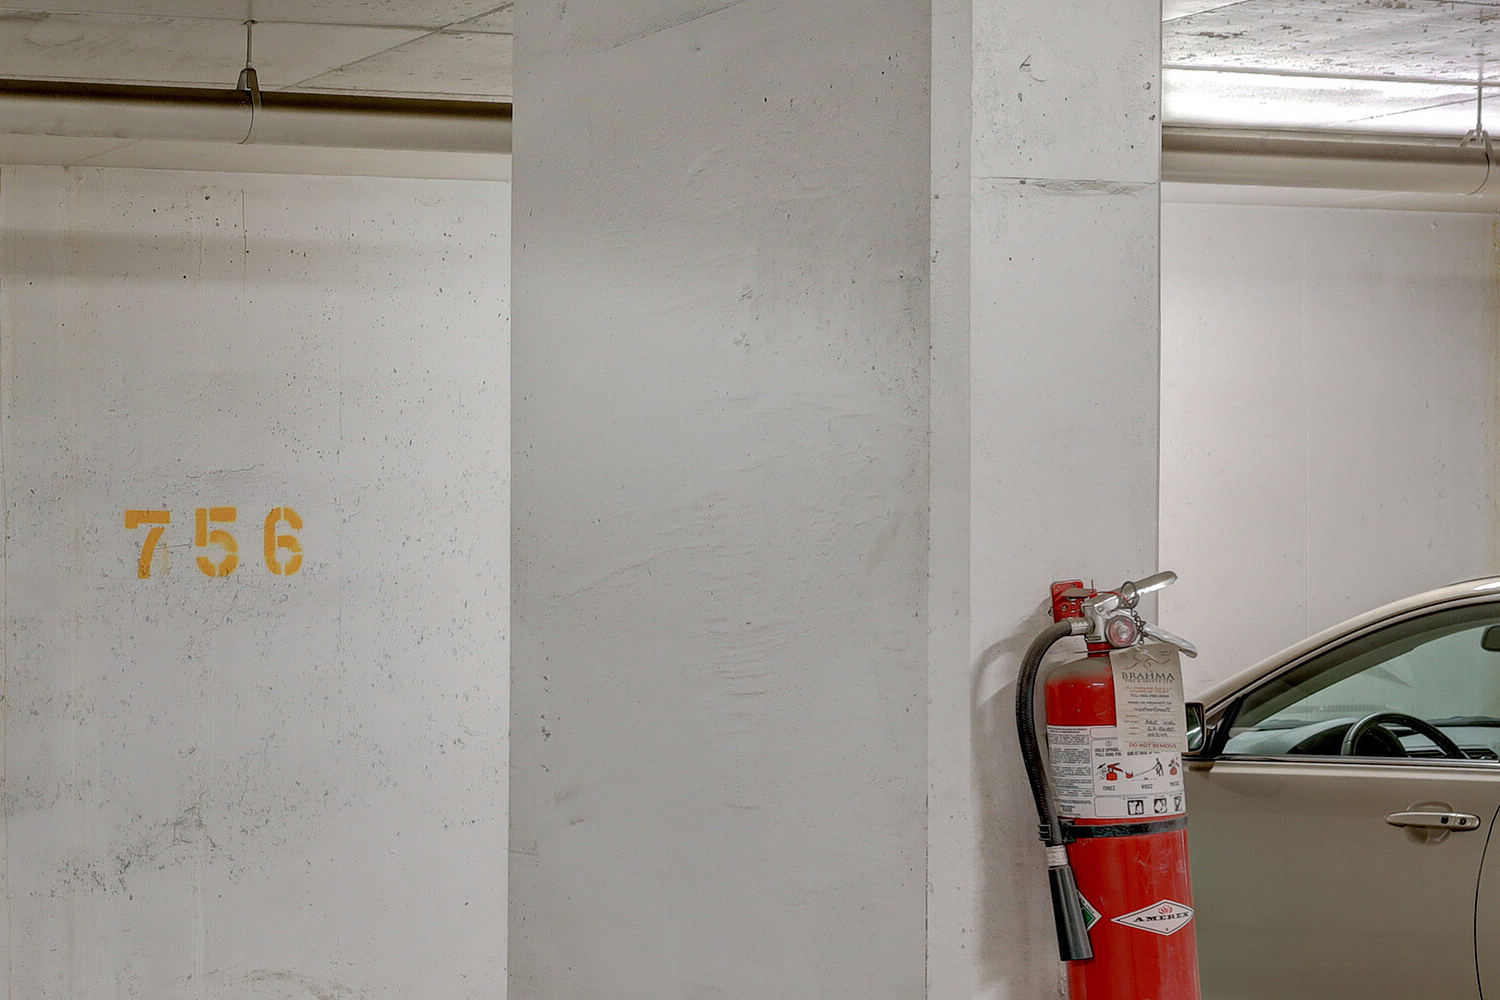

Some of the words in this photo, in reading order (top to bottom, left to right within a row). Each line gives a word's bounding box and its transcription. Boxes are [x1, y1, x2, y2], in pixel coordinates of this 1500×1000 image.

[124, 507, 303, 579] 756
[1122, 672, 1175, 680] BRAHMA
[1133, 911, 1189, 922] AMEREX
